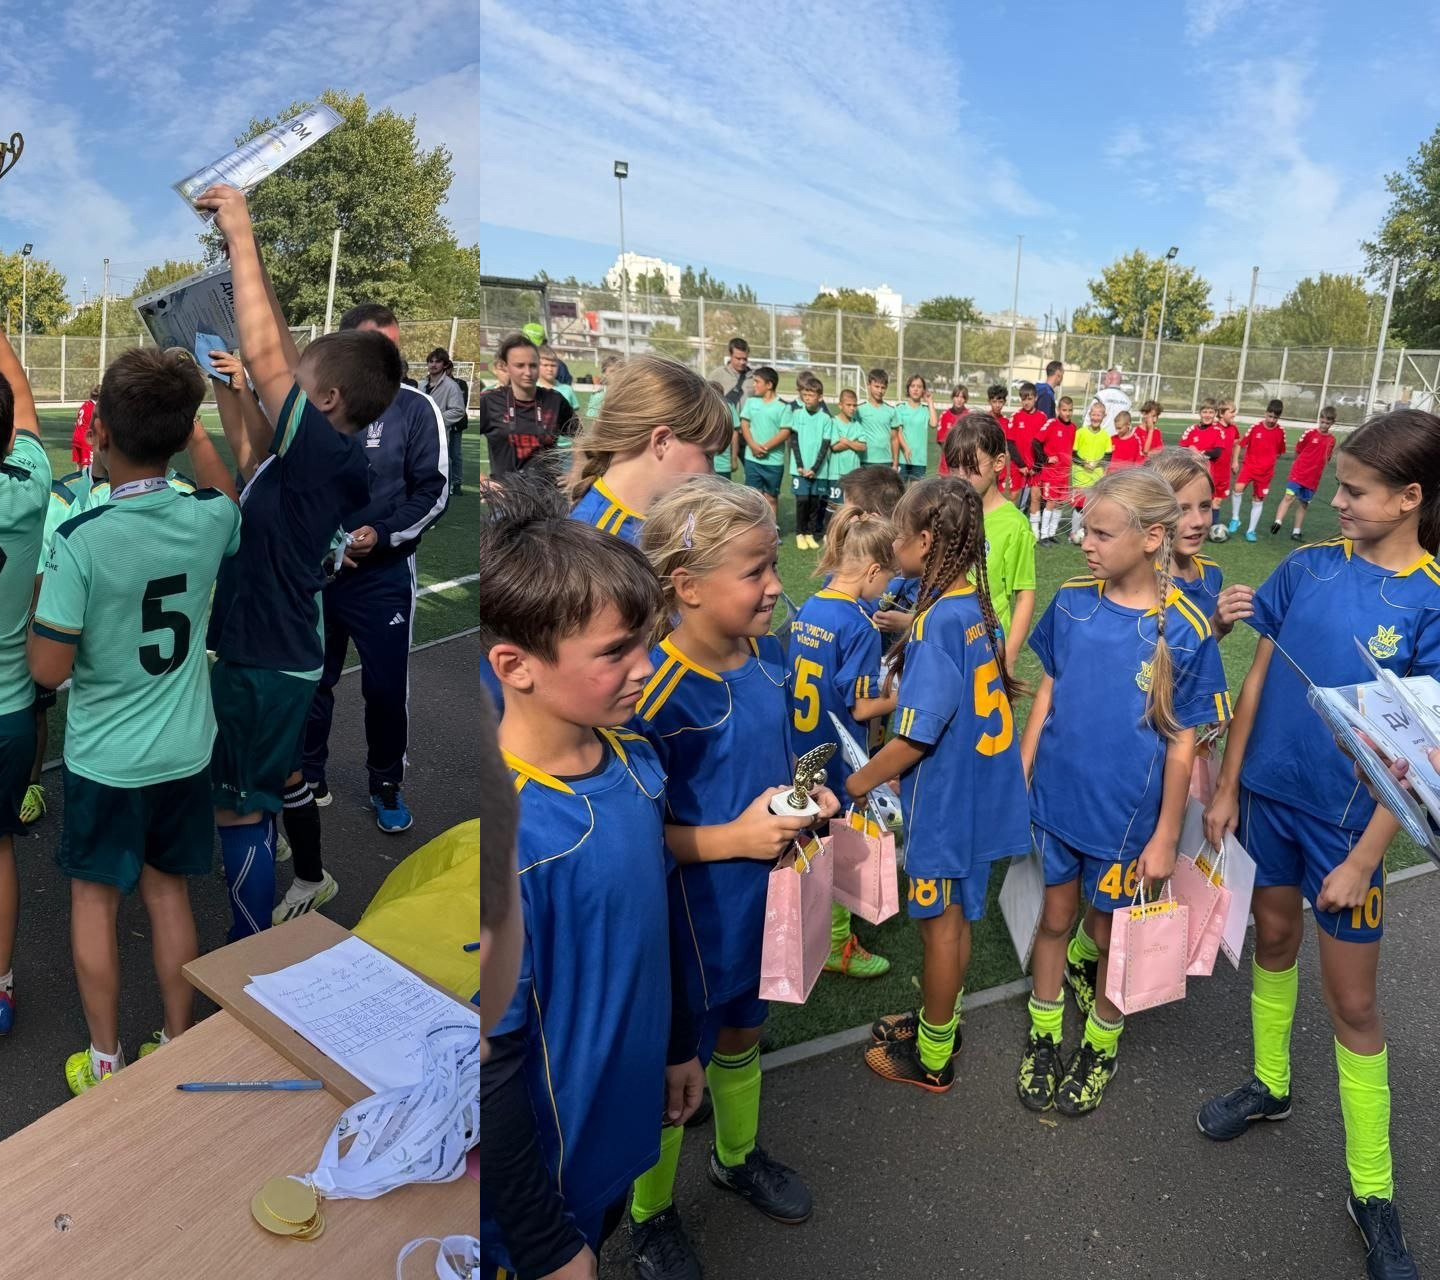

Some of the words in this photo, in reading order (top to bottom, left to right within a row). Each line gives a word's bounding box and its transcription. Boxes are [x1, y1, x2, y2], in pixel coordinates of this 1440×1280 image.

[792, 478, 800, 490] 9
[829, 486, 842, 499] 19
[138, 573, 191, 676] 5
[973, 657, 1014, 757] 5
[1098, 859, 1137, 900] 46
